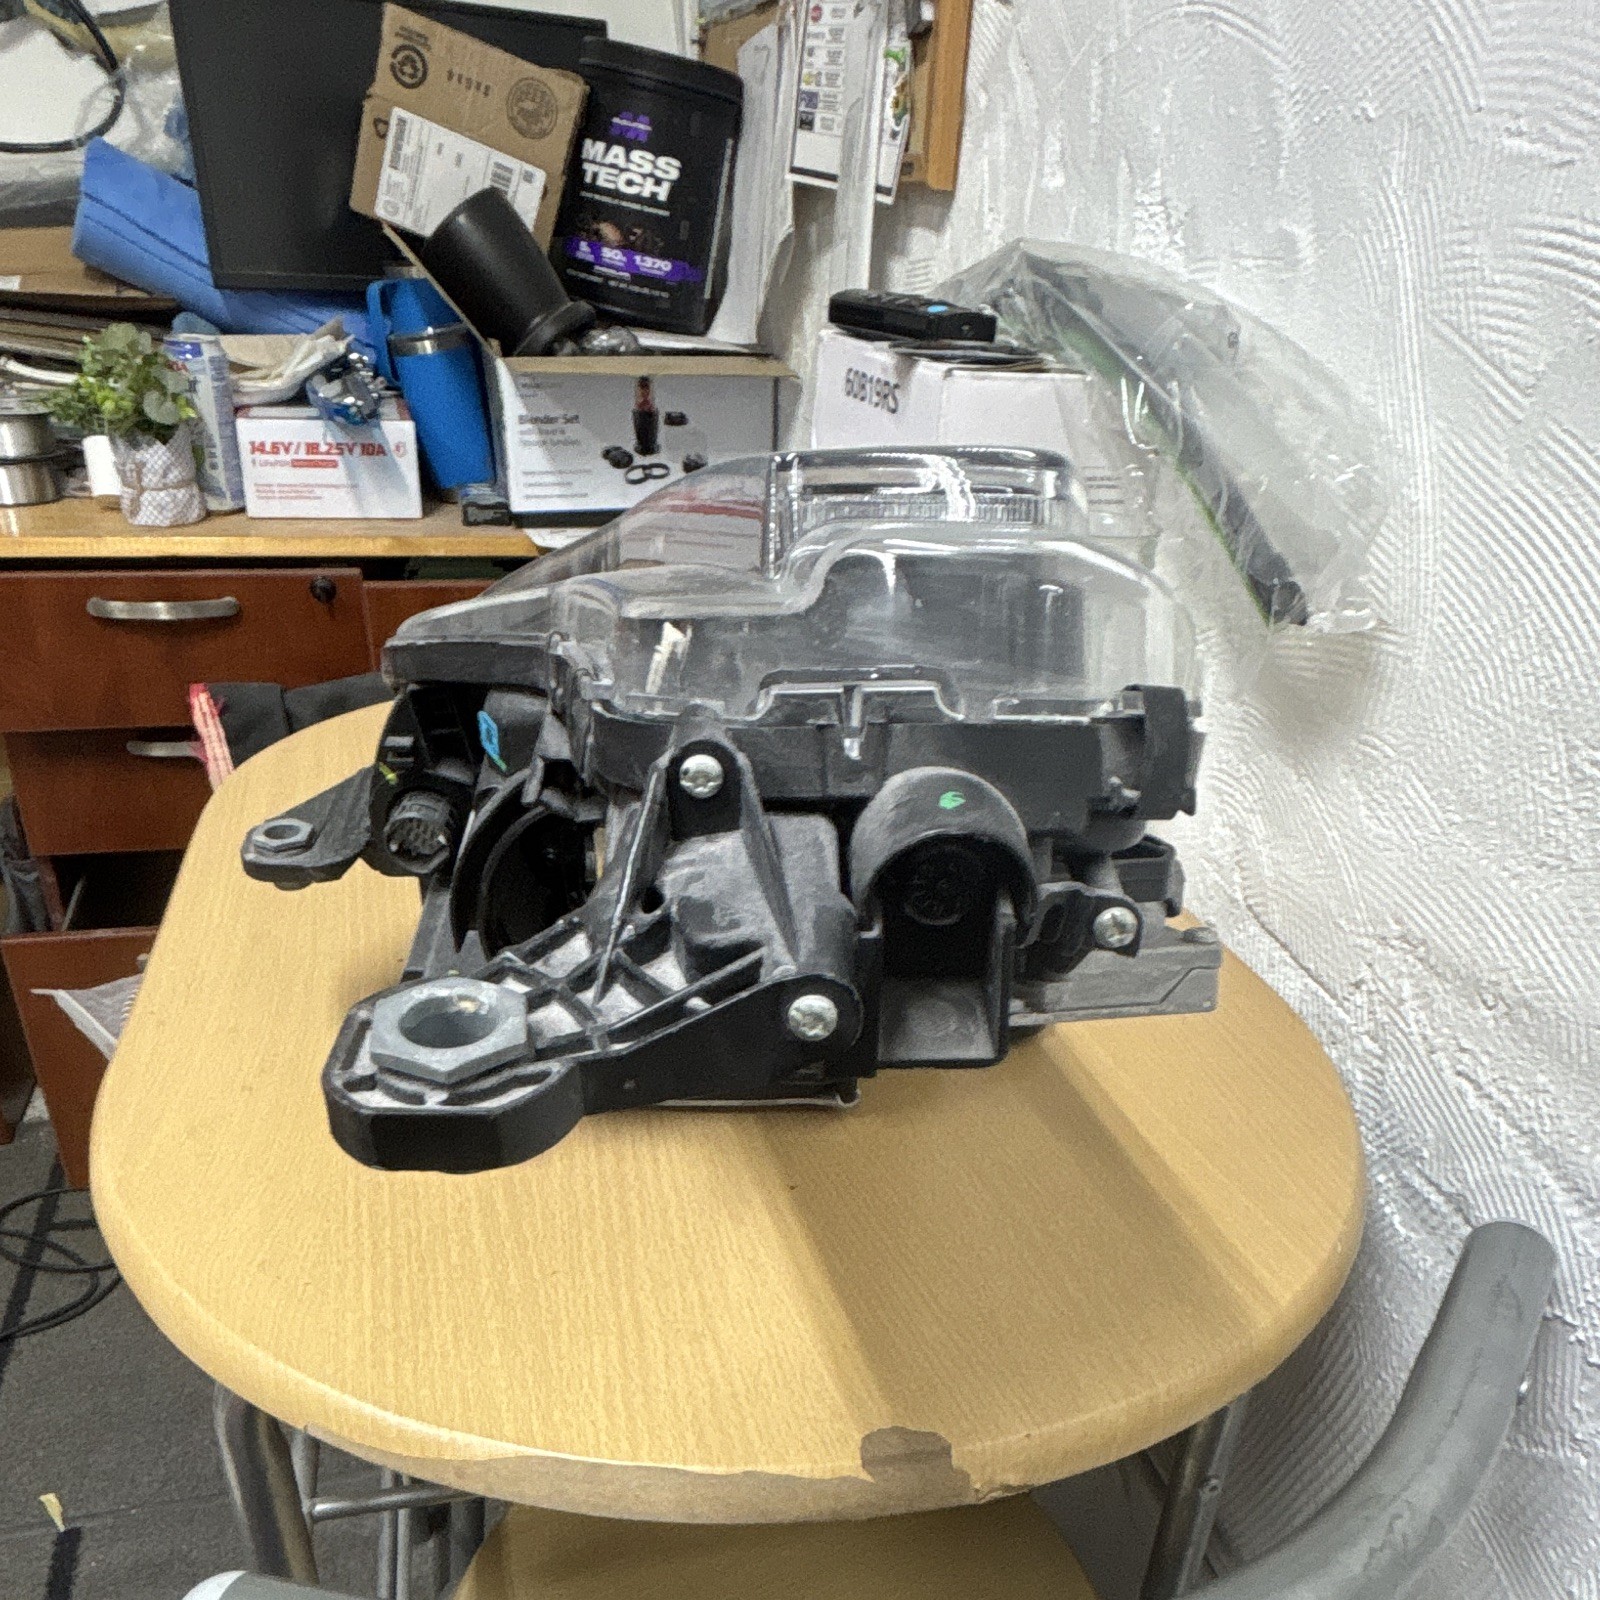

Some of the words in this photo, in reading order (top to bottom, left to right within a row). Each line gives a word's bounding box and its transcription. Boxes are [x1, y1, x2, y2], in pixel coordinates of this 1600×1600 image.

[581, 137, 682, 181] MASS
[581, 161, 672, 202] TECH
[249, 440, 294, 456] 14.6V
